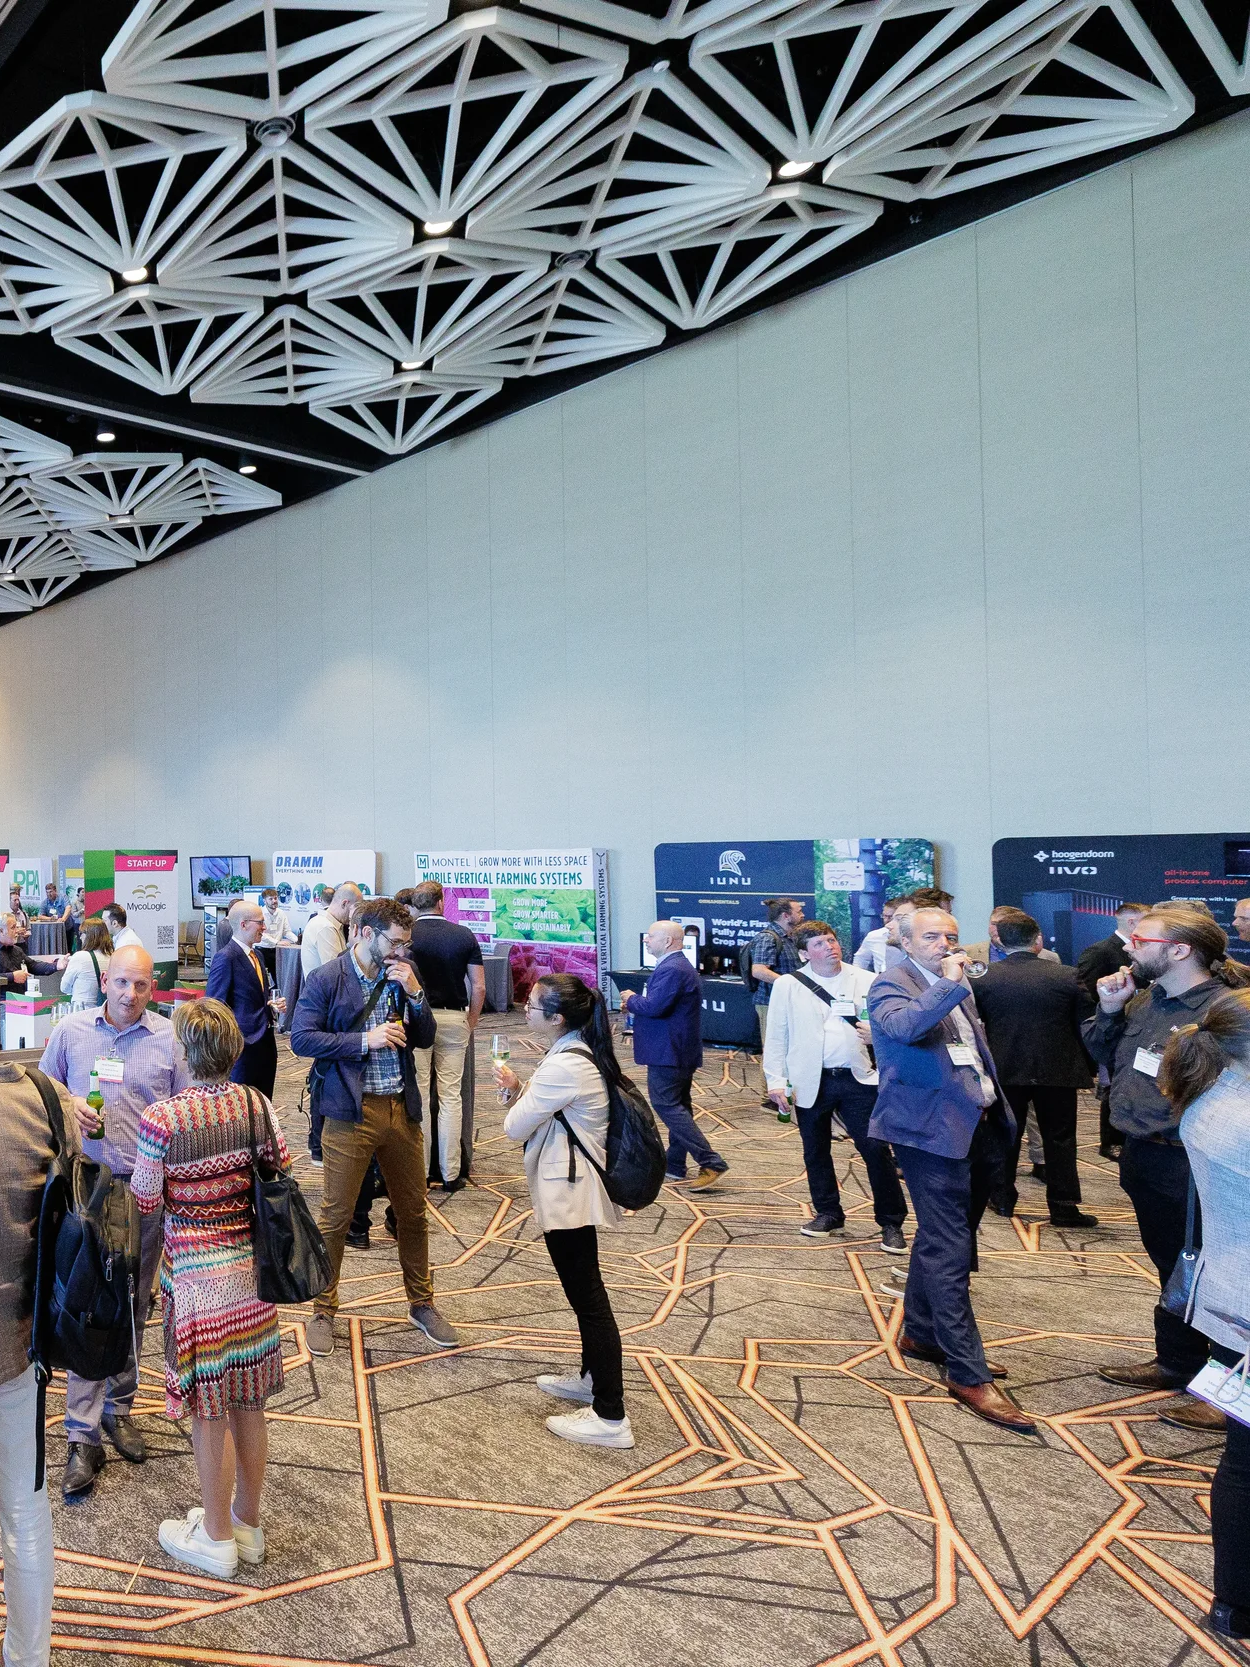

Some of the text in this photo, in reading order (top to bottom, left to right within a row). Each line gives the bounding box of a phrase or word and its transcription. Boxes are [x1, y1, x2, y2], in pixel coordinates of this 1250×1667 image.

[1052, 850, 1114, 859] hoogendoorn
[127, 860, 167, 868] START-UP
[276, 856, 323, 867] DRAMM
[432, 857, 470, 867] MONTEL
[479, 857, 499, 867] GROW
[501, 857, 521, 867] MORE
[524, 856, 543, 866] WITH
[545, 856, 562, 866] LESS
[564, 855, 588, 866] SPACE
[13, 870, 41, 896] PPA
[422, 872, 583, 885] MOBILE VERTICAL FARMING SYSTEMS
[710, 877, 751, 885] IUNU
[126, 902, 167, 912] MycoLogic
[513, 898, 548, 907] GROW MORE
[513, 910, 559, 920] GROW SMARTER
[599, 901, 607, 931] FARMING
[513, 922, 571, 932] GROW SUSTAINABLY
[711, 918, 748, 928] World's
[712, 928, 736, 937] Fully
[712, 938, 736, 947] Crop
[599, 932, 607, 965] VERTICAL
